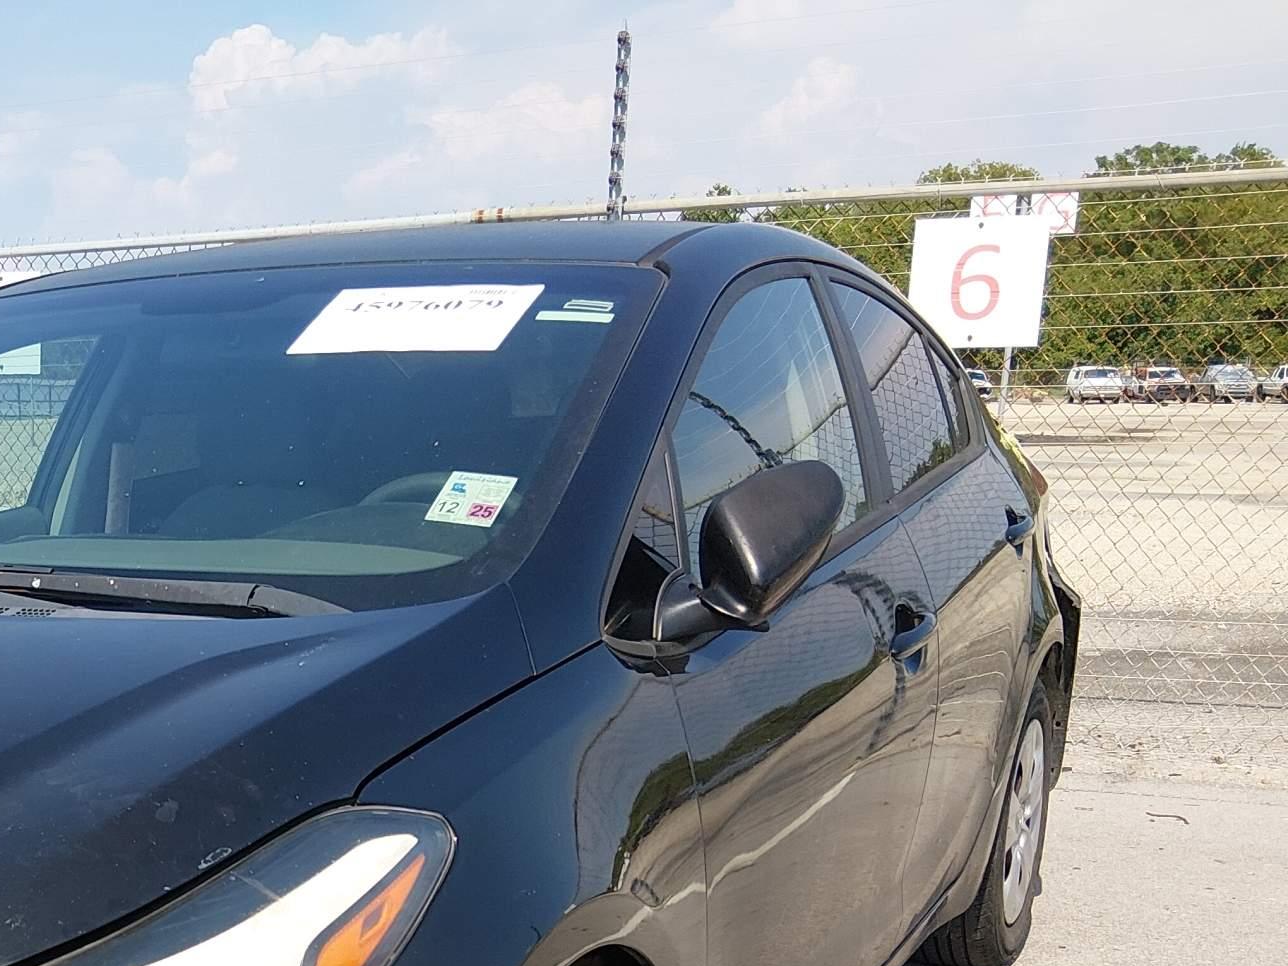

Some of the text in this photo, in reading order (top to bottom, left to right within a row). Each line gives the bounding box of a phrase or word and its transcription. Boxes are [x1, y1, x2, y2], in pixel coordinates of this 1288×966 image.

[951, 244, 1001, 321] 6
[438, 500, 495, 519] 12 25
